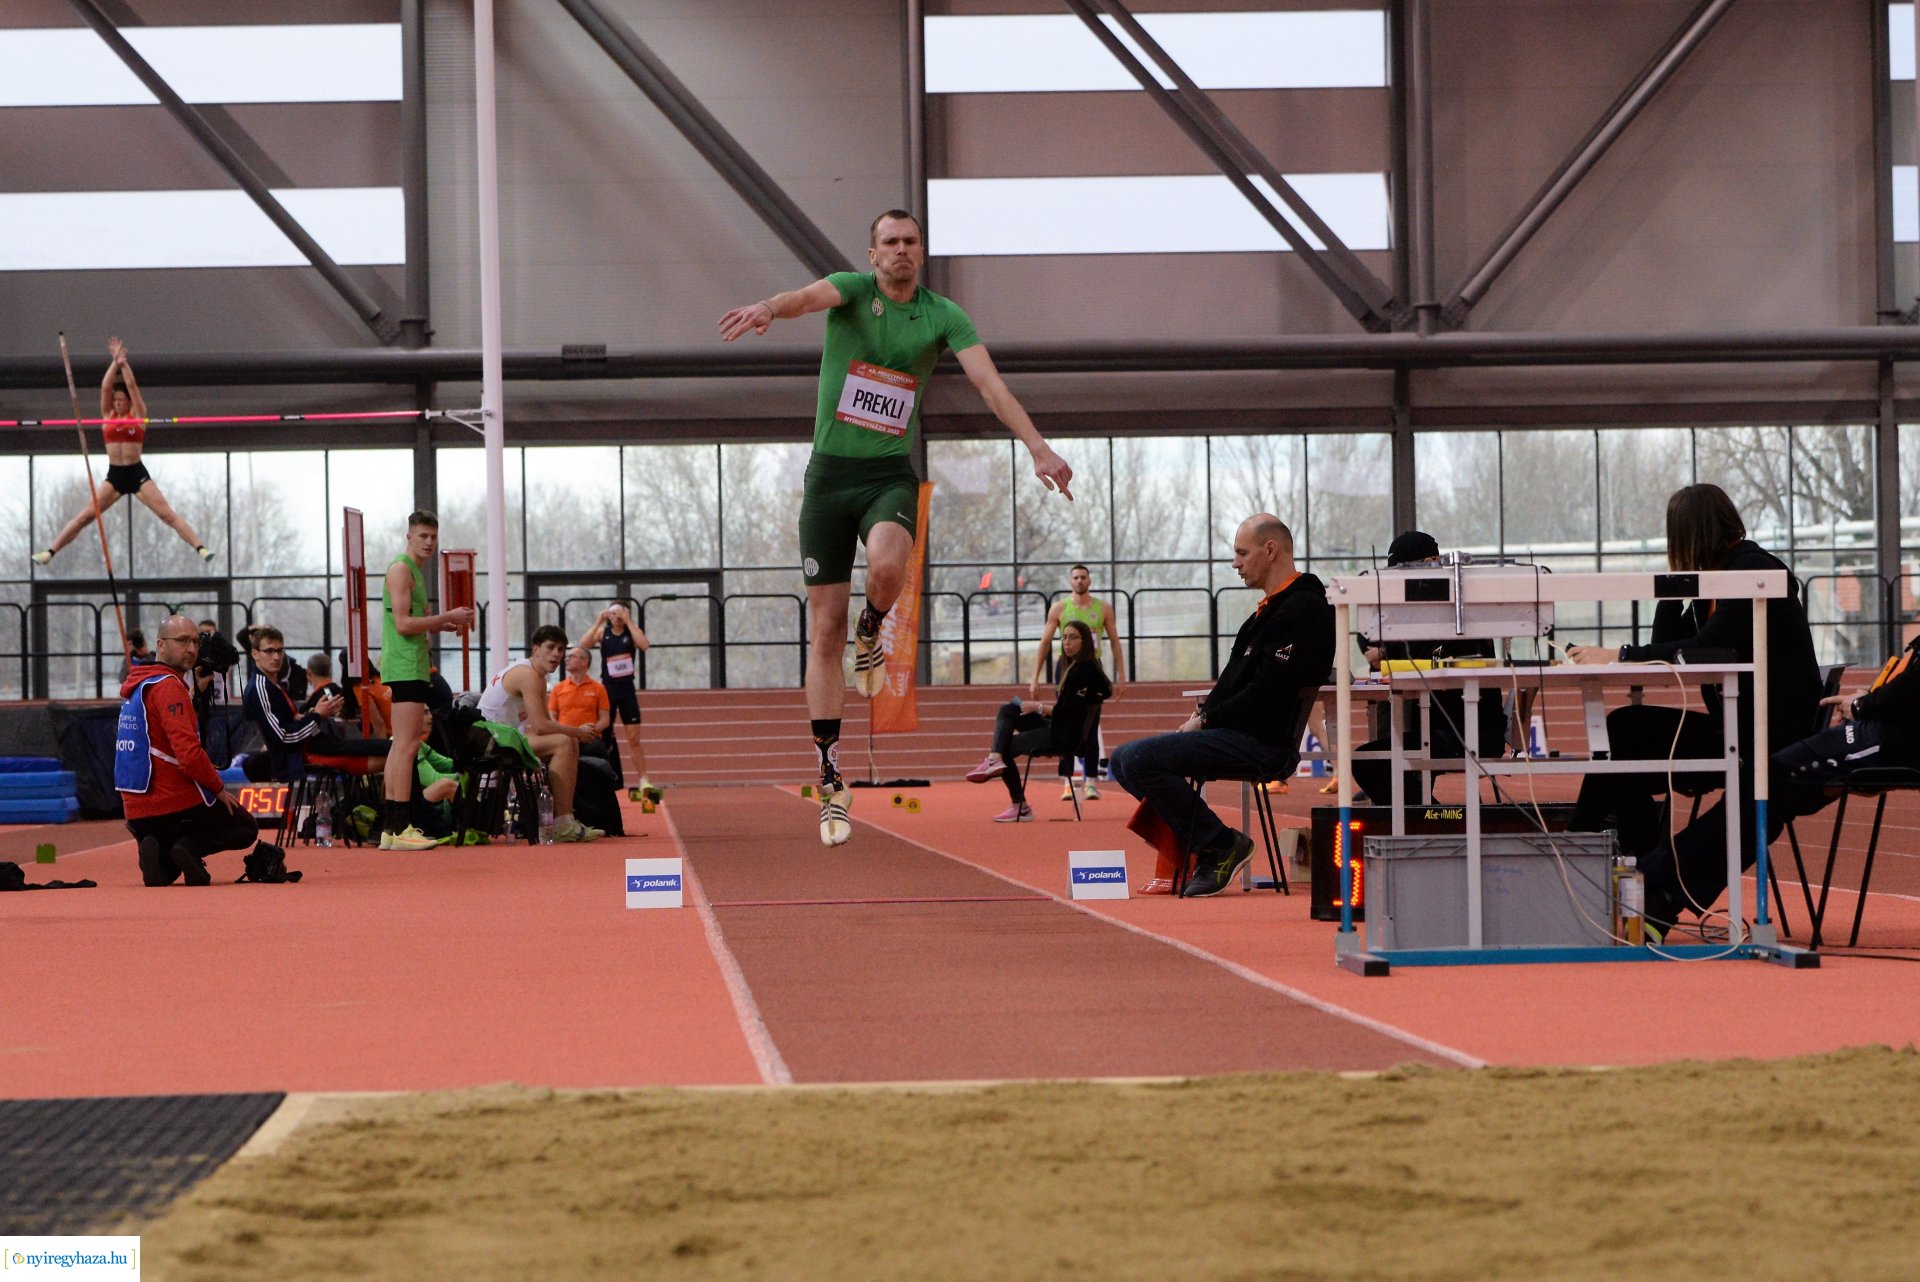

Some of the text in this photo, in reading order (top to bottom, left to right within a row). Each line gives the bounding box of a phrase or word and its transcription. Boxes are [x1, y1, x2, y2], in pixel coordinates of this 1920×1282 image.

[852, 389, 905, 419] PREKLI
[1845, 725, 1855, 744] JAKO
[1088, 870, 1122, 881] polanik
[643, 878, 677, 889] polanik
